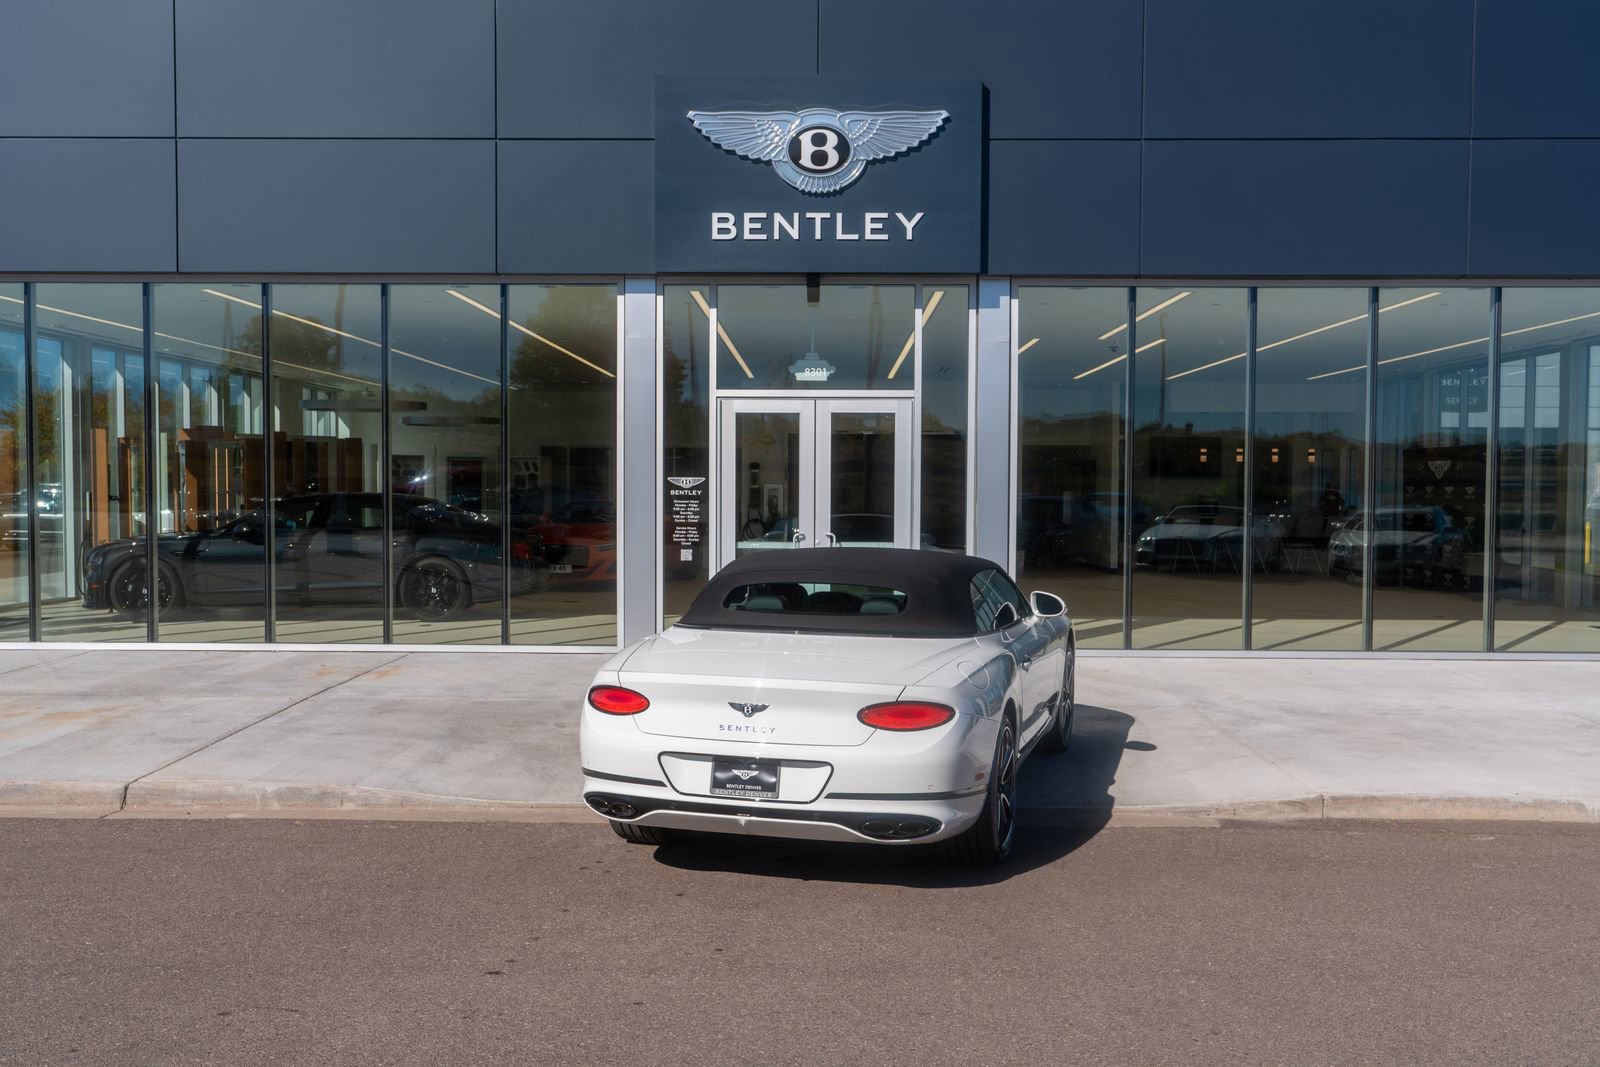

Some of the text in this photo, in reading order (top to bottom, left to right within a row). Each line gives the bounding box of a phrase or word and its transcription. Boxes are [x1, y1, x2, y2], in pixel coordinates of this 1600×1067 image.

[798, 129, 840, 170] B
[711, 212, 925, 241] BENTLEY
[804, 367, 827, 377] 8301
[745, 791, 772, 799] DENVER
